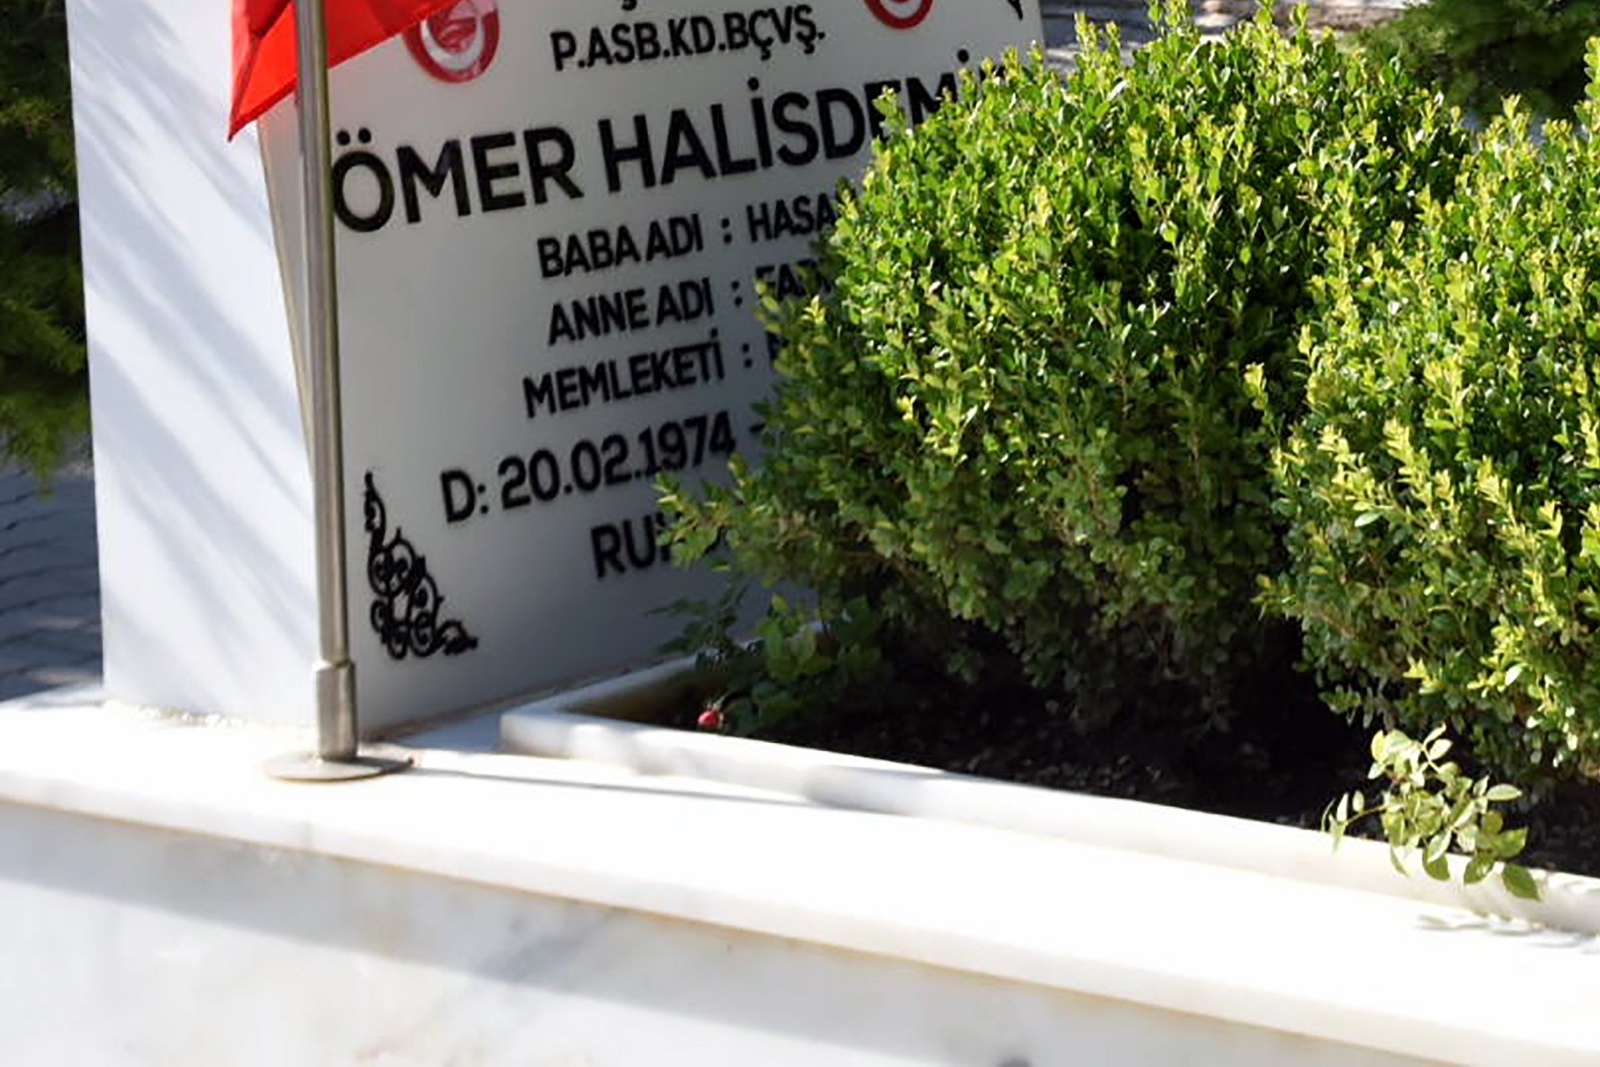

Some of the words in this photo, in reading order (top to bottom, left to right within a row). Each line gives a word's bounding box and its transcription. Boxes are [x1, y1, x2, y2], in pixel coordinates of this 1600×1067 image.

[331, 128, 584, 233] ÖMER
[522, 327, 727, 420] MEMLEKETİ
[498, 410, 737, 511] 20.02.1974
